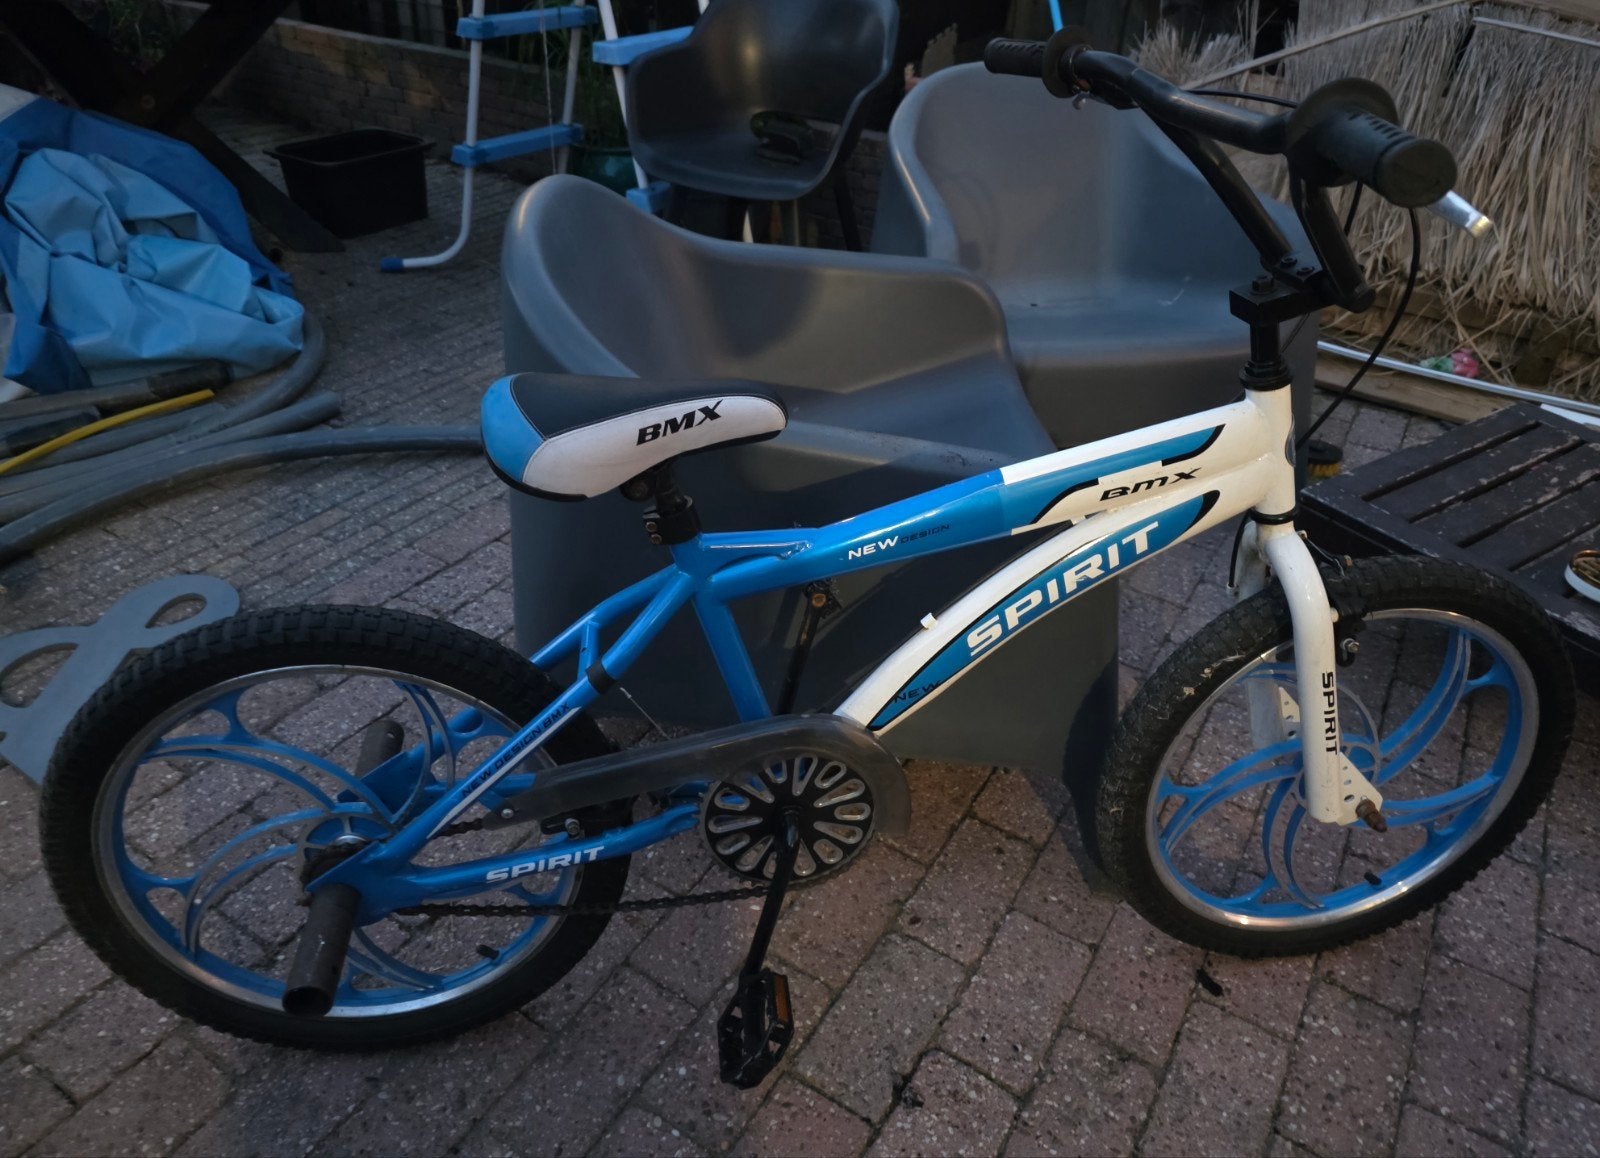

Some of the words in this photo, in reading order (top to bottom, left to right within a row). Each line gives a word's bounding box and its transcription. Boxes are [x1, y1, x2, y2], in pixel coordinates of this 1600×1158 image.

[636, 399, 723, 445] BMX
[848, 535, 899, 560] NEW
[900, 524, 950, 543] DESIGN
[967, 521, 1158, 656] SPIRIT
[1322, 672, 1337, 755] SPIRIT
[461, 770, 492, 797] NEW
[494, 727, 542, 769] DESIGN
[542, 702, 570, 728] BMX
[486, 846, 604, 884] SPIRIT
